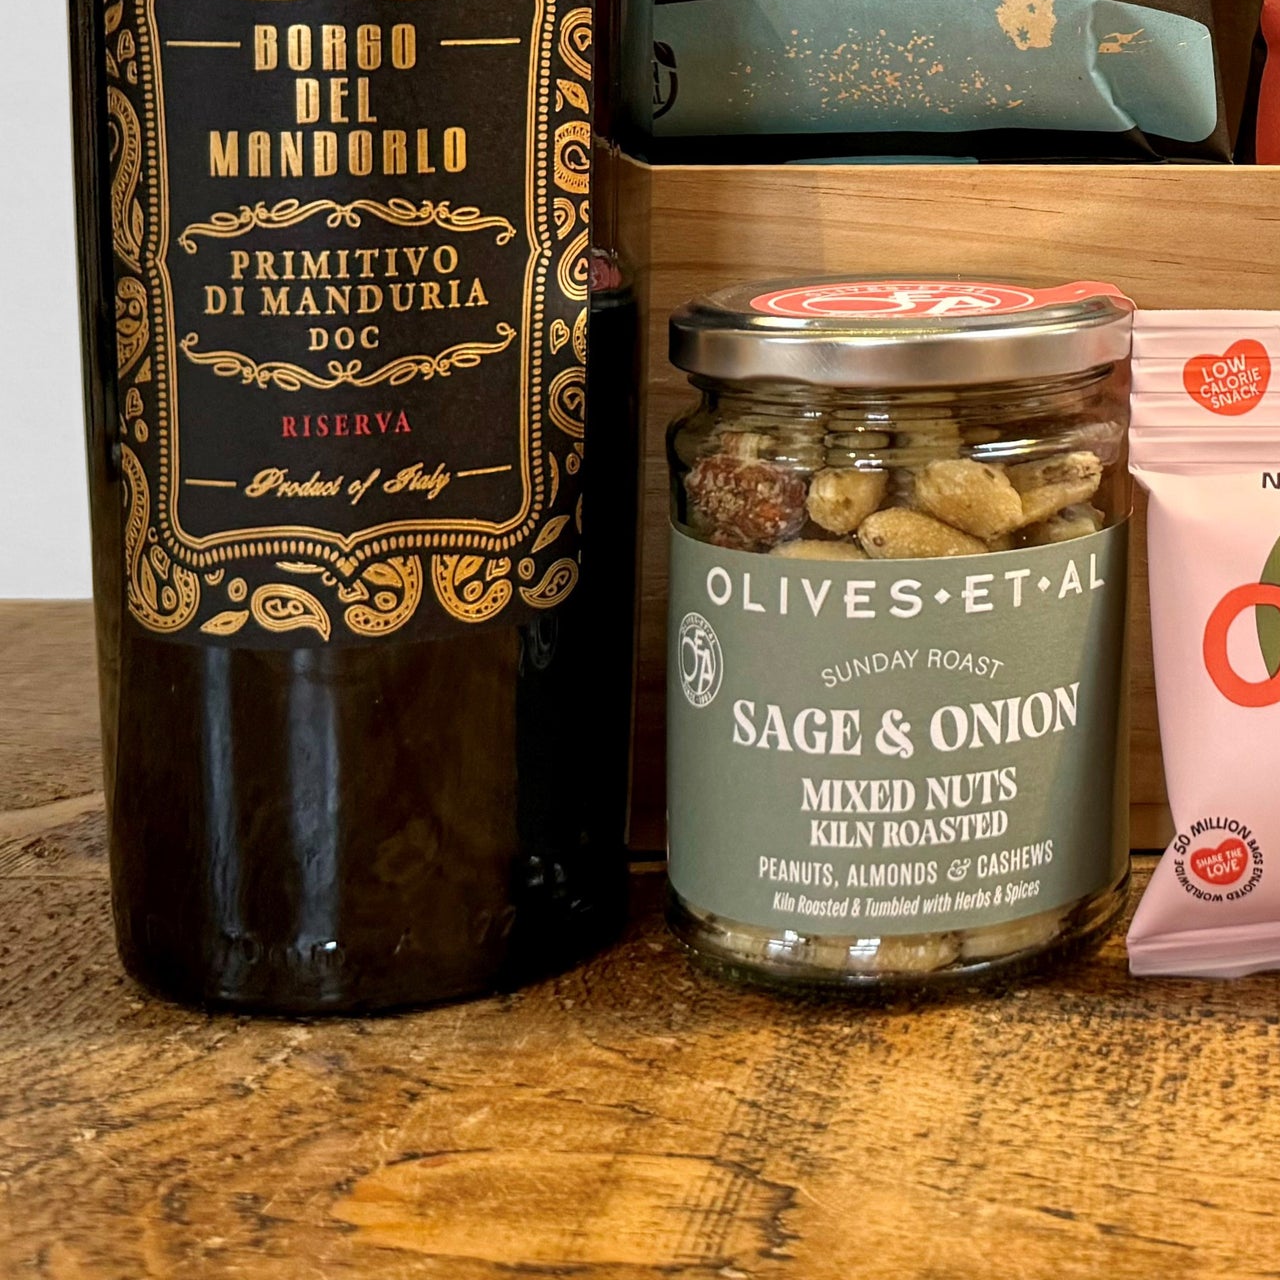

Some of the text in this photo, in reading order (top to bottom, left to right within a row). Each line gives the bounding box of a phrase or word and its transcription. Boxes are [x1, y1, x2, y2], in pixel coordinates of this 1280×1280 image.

[254, 23, 417, 71] BORGO
[295, 76, 378, 125] DEL
[208, 126, 468, 178] MANDORLO
[230, 244, 459, 281] PRIMITIVO
[204, 277, 490, 316] DI MANDURIA
[307, 325, 380, 352] DOC
[1200, 367, 1262, 398] CALORIE
[1201, 353, 1246, 383] LOW
[1211, 382, 1260, 409] SNACK
[281, 408, 413, 438] RISERVA
[245, 461, 451, 505] Product of Italy
[821, 648, 1004, 688] SUNDAY ROAST
[732, 681, 1081, 759] SAGE & ONION
[800, 766, 1018, 813] MIXED NUTS
[810, 809, 1009, 848] KILN ROASTED
[759, 839, 1054, 889] PEANUTS, ALMONDS & CASHEWS
[1173, 816, 1264, 902] 50 MILLION BAGS ENJOYED WORLDWIDE
[1195, 847, 1243, 869] SHARE THE
[1206, 858, 1240, 879] LOVE
[773, 877, 1041, 918] Kiln Roasted & Tumbled with Herbs & Spices
